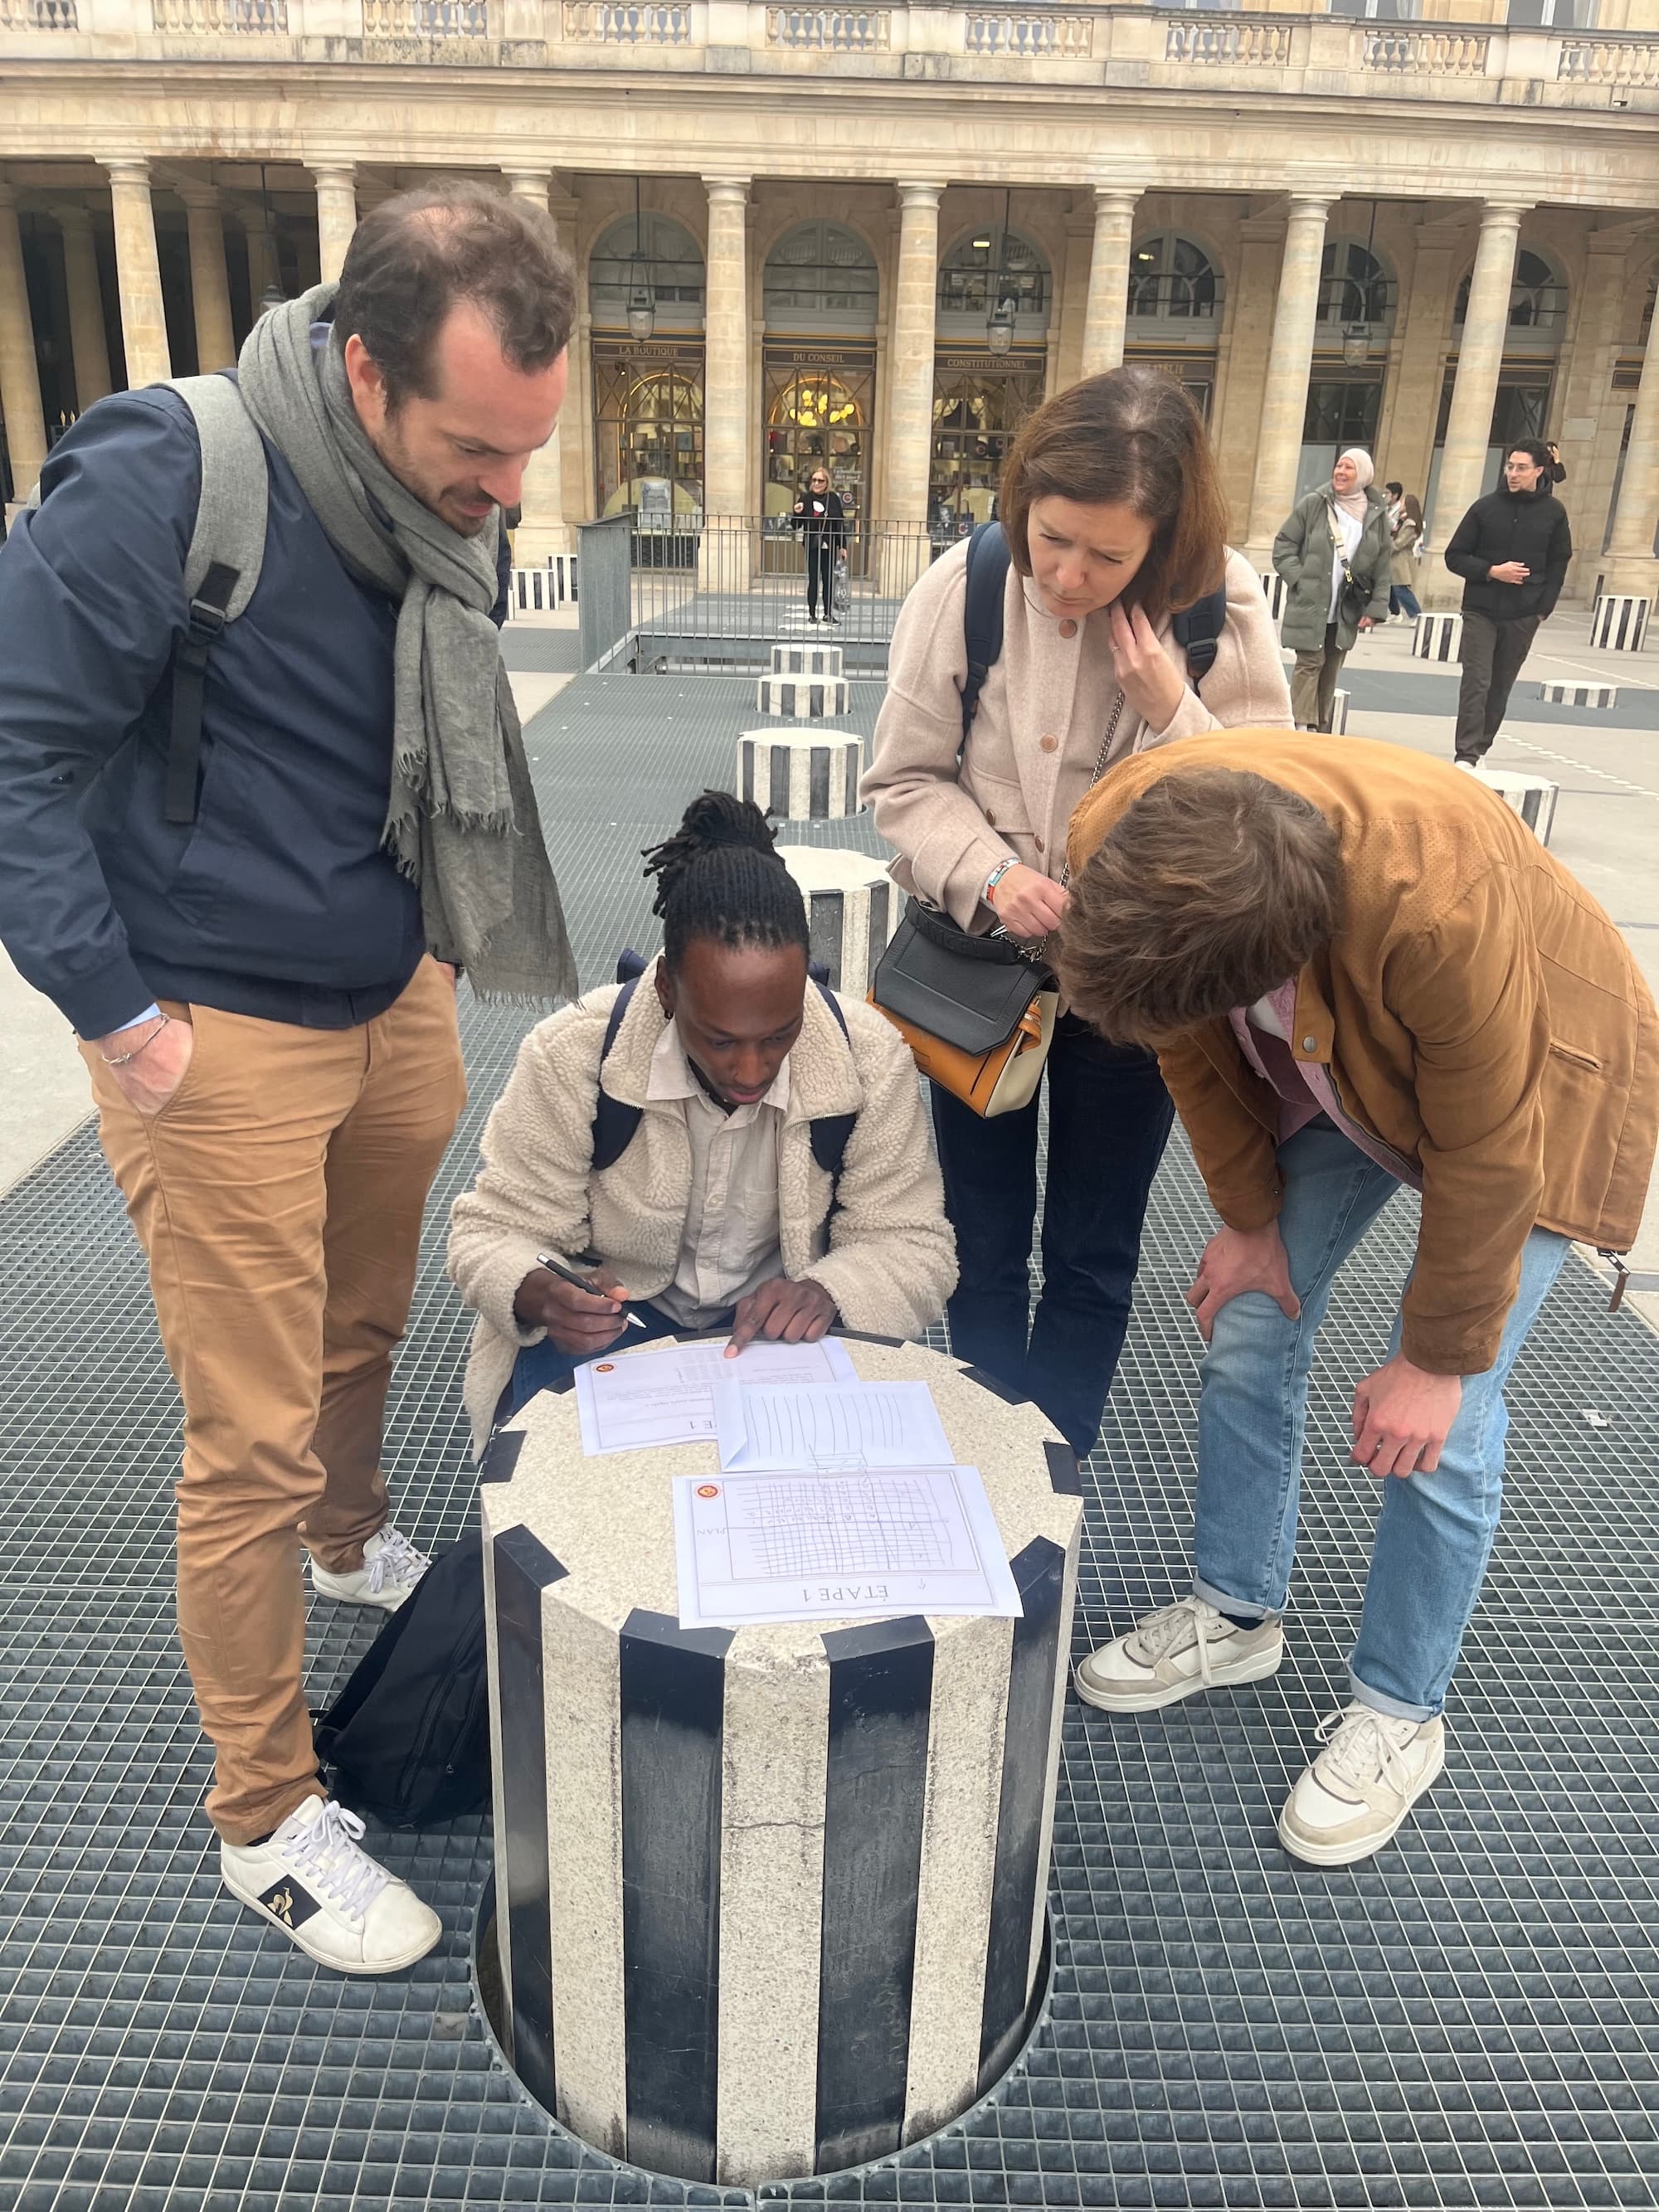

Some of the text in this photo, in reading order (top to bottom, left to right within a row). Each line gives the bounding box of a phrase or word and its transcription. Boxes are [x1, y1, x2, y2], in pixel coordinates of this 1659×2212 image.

[619, 346, 679, 357] LA BOUTIQUE
[793, 352, 845, 363] DU CONSEIL
[946, 358, 1027, 369] CONSTITUTIONNEL
[803, 1585, 889, 1602] ÉTAPE 1
